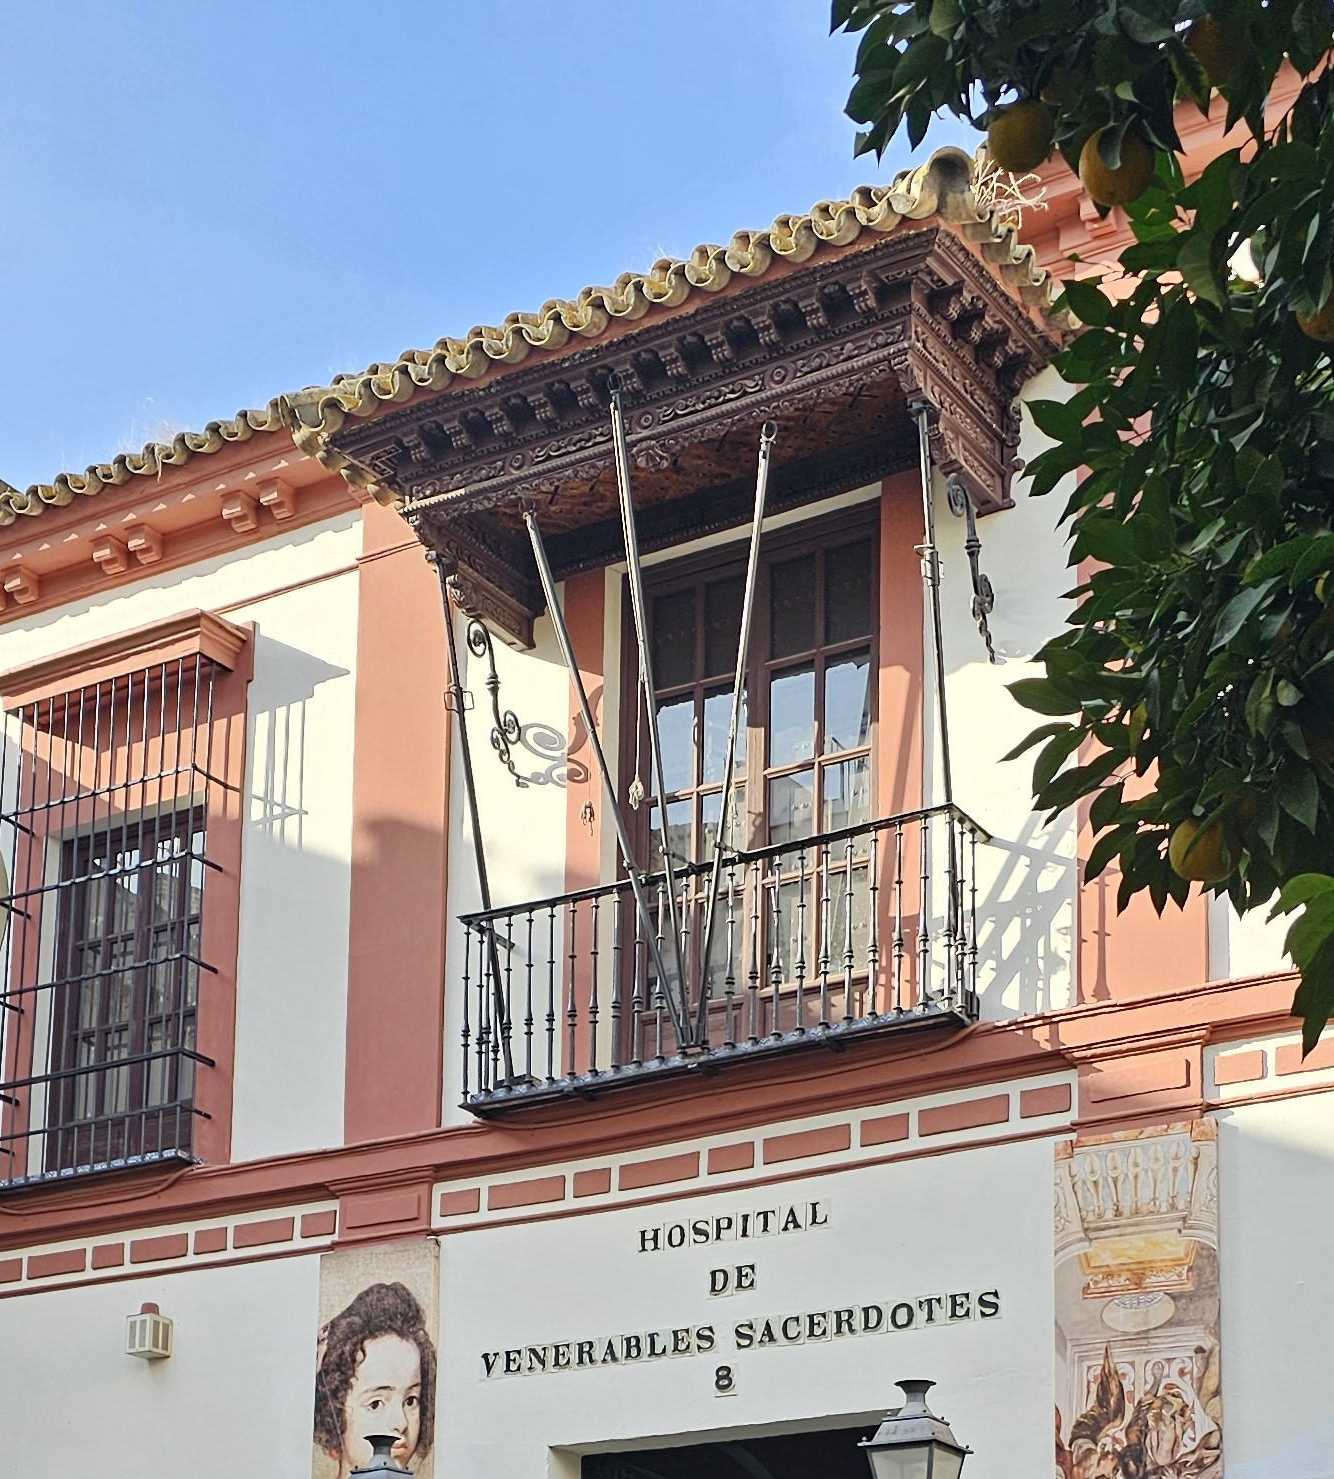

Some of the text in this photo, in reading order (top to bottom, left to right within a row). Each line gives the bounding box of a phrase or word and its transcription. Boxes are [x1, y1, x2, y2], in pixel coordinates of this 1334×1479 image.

[638, 1201, 828, 1253] HOSPITAL
[710, 1263, 757, 1297] DE
[481, 1289, 1002, 1378] VENERABLES SACERDOTES
[714, 1365, 734, 1392] 8
